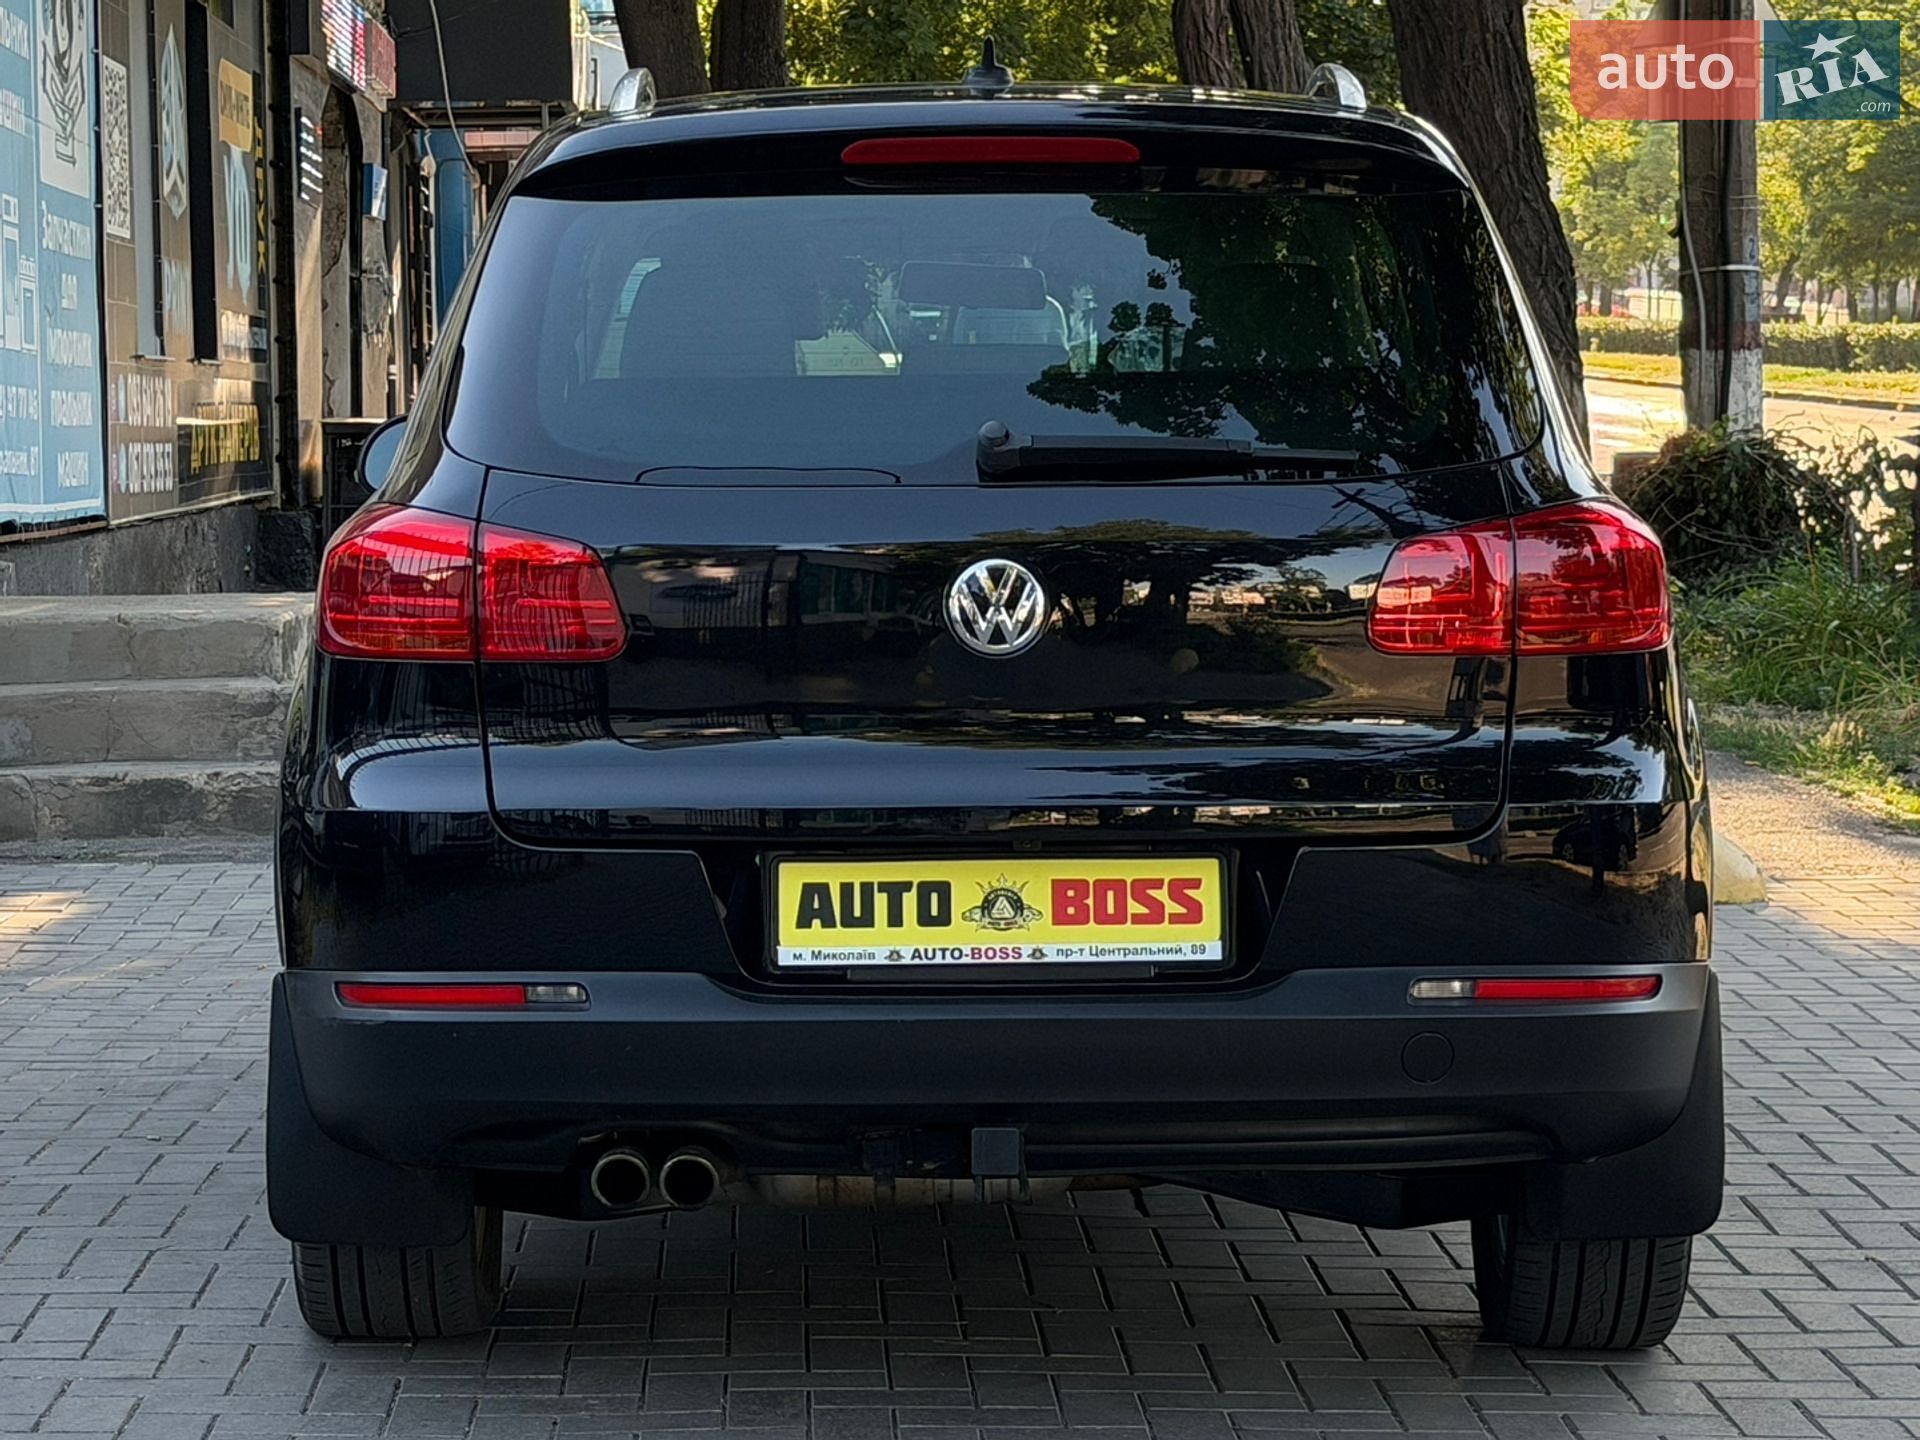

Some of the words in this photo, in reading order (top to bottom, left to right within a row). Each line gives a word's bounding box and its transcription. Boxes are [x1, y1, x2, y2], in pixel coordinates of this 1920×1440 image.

[795, 881, 953, 929] AUTO
[1050, 878, 1204, 926] BOSS
[792, 952, 807, 961] м.
[811, 949, 876, 961] Миколаїв
[910, 946, 1023, 961] AUTO-BOSS
[1056, 947, 1086, 958] пр-т
[1089, 944, 1187, 960] Центральний,
[1190, 943, 1207, 955] 89
